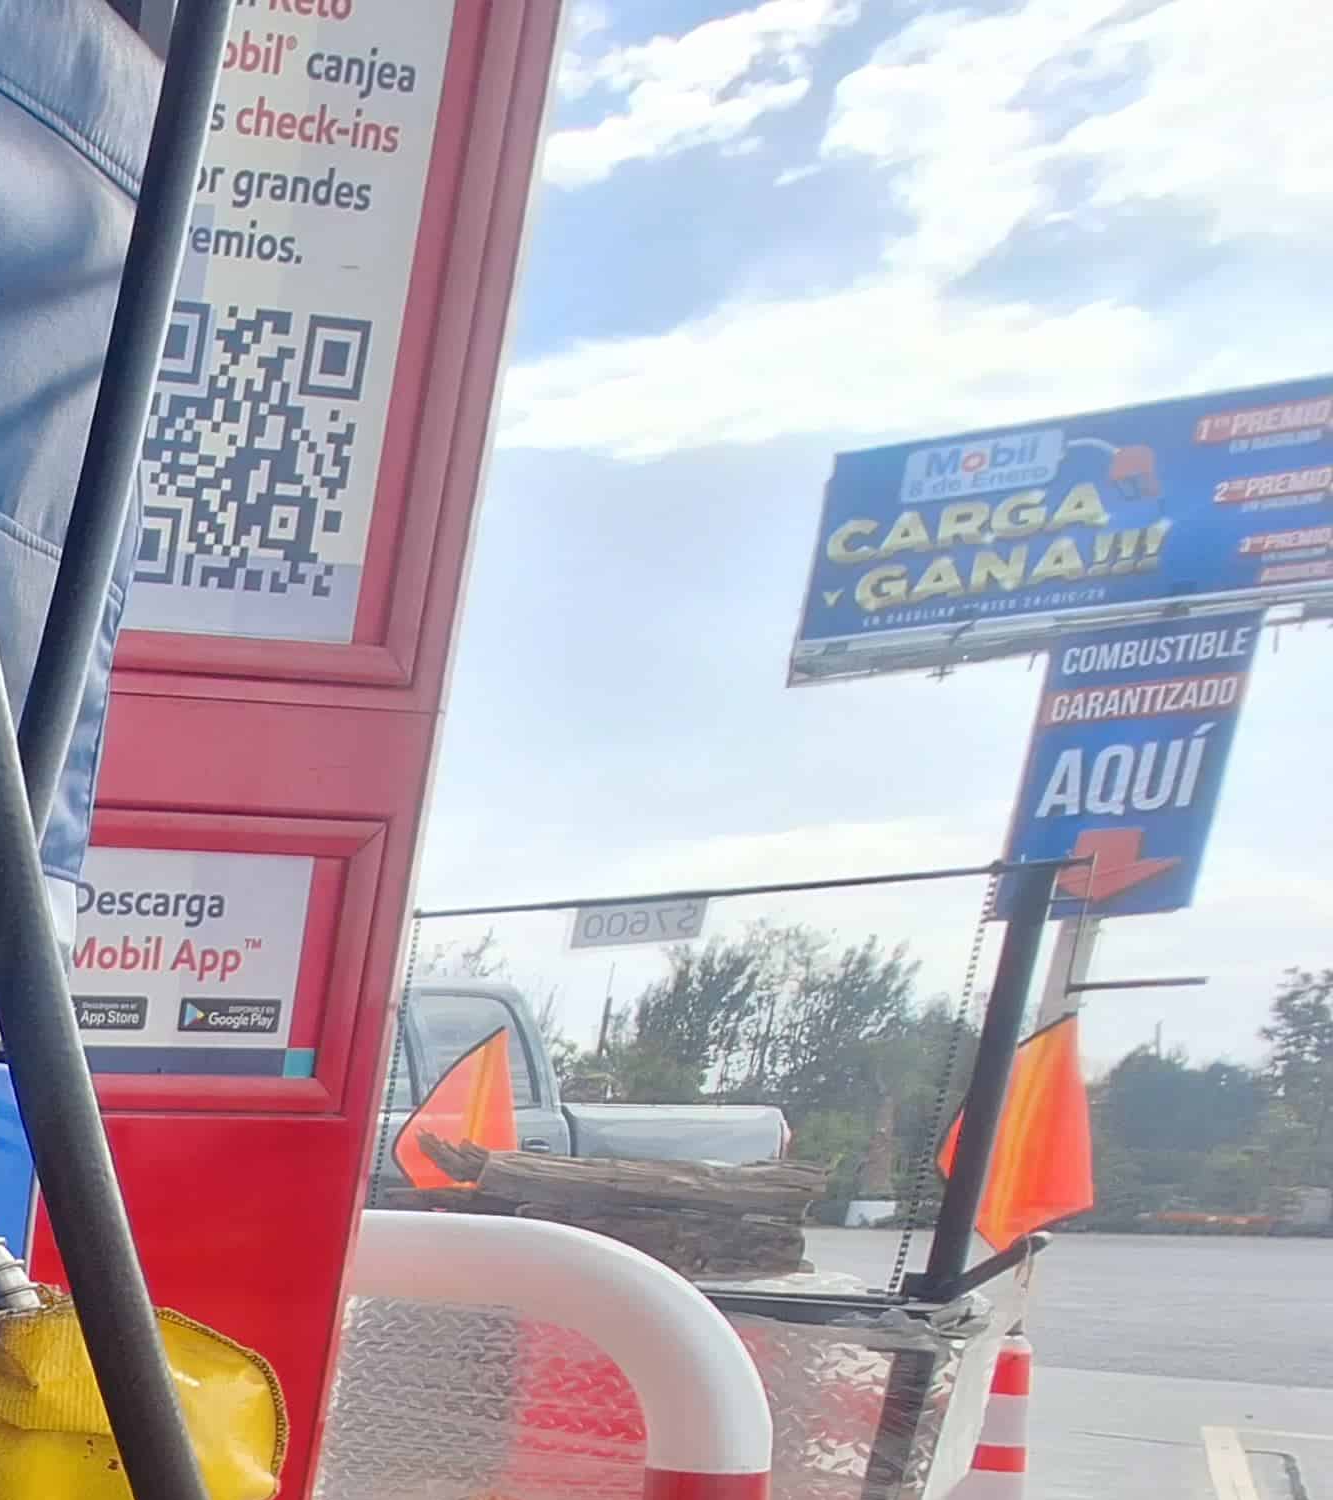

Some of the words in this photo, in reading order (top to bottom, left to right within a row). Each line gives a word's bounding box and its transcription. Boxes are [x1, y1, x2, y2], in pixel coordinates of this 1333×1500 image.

[306, 47, 416, 99] canjea
[235, 96, 400, 153] check-ins
[232, 167, 371, 210] grandes
[925, 437, 1038, 478] Mobil
[929, 476, 962, 495] de
[971, 465, 1049, 489] Enero
[826, 482, 1111, 564] CARGA
[854, 518, 1173, 611] GANA!!!
[1061, 625, 1253, 676] COMBUSTIBLE
[1051, 677, 1238, 723] GARANTIZADO
[1035, 722, 1216, 818] AQUÍ
[77, 881, 225, 927] Descarga
[72, 935, 163, 971] Mobil
[80, 1010, 105, 1025] App
[108, 1010, 140, 1025] Store
[208, 1012, 249, 1029] Google
[249, 1014, 275, 1029] Play
